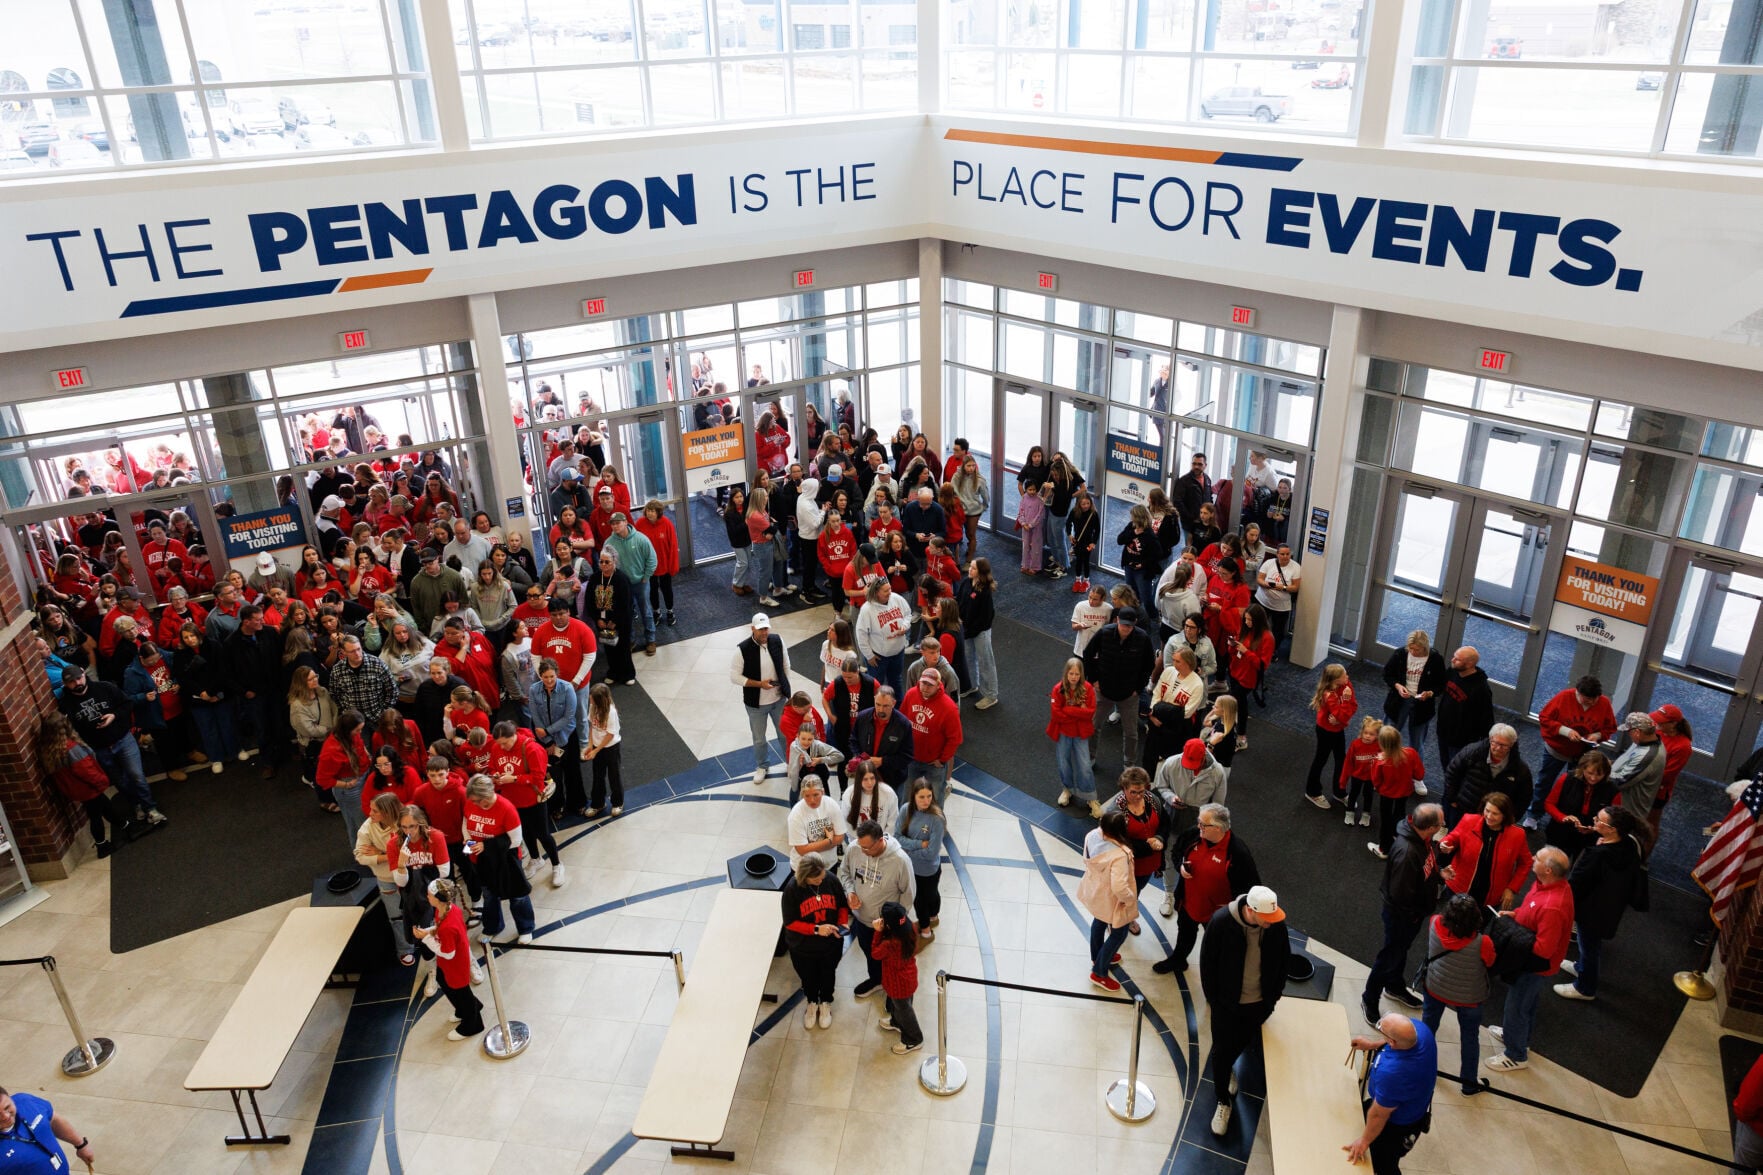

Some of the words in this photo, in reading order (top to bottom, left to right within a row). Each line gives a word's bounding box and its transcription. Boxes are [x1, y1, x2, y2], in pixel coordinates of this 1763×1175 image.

[26, 219, 223, 291] THE
[249, 173, 697, 272] PENTAGON
[730, 174, 769, 213] IS
[785, 163, 877, 207] THE
[953, 159, 1085, 213] PLACE
[1111, 172, 1242, 240] FOR
[1266, 187, 1643, 292] EVENTS.
[798, 270, 814, 287] EXIT
[1038, 273, 1054, 289] EXIT
[586, 298, 605, 316] EXIT
[1231, 306, 1251, 325] EXIT
[343, 330, 366, 349] EXIT
[1481, 350, 1507, 370] EXIT
[57, 368, 84, 388] EXIT
[688, 445, 704, 455] FOR
[706, 438, 739, 451] VISITING
[691, 435, 717, 445] THANK
[720, 431, 735, 440] YOU
[701, 449, 728, 461] TODAY!
[1115, 442, 1140, 454] THANK
[1142, 449, 1157, 459] YOU
[1112, 450, 1126, 460] FOR
[1128, 454, 1160, 470] VISITING
[1122, 461, 1148, 475] TODAY!
[230, 518, 268, 532] THANK
[270, 514, 291, 524] YOU
[229, 531, 252, 543] FOR
[252, 522, 298, 538] VISITING
[246, 535, 285, 549] TODAY!
[1575, 567, 1615, 586] THANK
[1620, 578, 1645, 593] YOU
[1567, 575, 1591, 591] FOR
[1594, 582, 1646, 606] VISITING
[1582, 591, 1626, 611] TODAY!
[1576, 625, 1615, 642] PENTAGON
